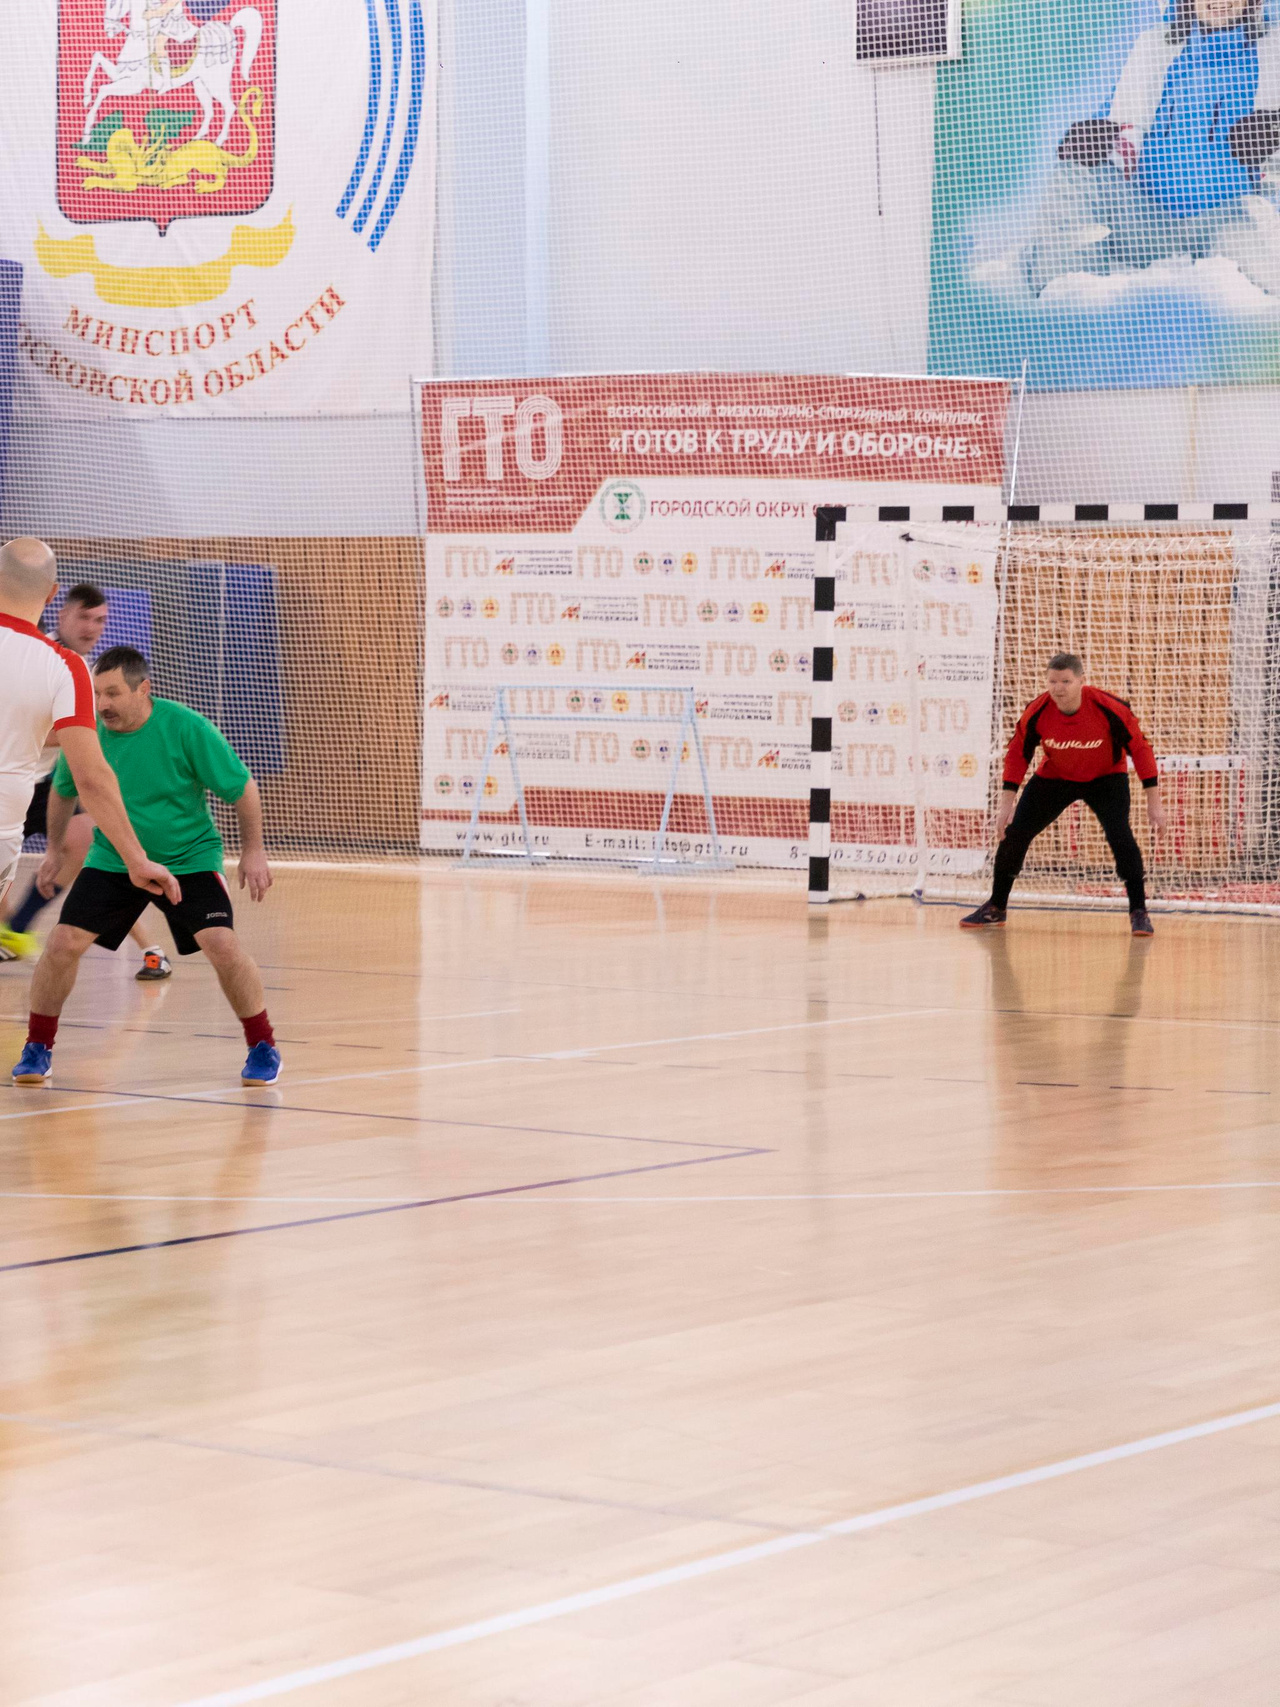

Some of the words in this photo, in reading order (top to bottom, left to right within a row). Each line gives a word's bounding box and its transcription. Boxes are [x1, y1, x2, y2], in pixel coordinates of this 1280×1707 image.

[62, 298, 259, 357] МИНСПОРТ
[19, 322, 194, 406] СКОВСКОЙ
[204, 284, 346, 398] ОБЛАСТИ
[442, 395, 563, 481] ГТО
[609, 429, 699, 454] «ГОТОВ
[706, 430, 721, 453] К
[729, 430, 811, 458] ТРУДУ
[816, 431, 836, 455] И
[842, 430, 982, 459] ОБОРОНЕ»
[650, 497, 751, 518] ГОРОДСКОЙ
[756, 500, 808, 519] ОКРУГ
[444, 545, 489, 577] ГТО
[577, 545, 623, 578] ГТО
[709, 547, 760, 580] ГТО
[510, 592, 555, 625] ГТО
[643, 593, 688, 627] ГТО
[780, 596, 814, 630] ГТ
[445, 636, 489, 668] ГТО
[577, 639, 620, 671] ГТО
[705, 640, 757, 676] ГТО
[510, 689, 555, 714] ГТО
[641, 691, 684, 716] ГТО
[777, 691, 813, 726] ГТ
[445, 728, 488, 760] ГТО
[574, 730, 619, 764] ГТО
[702, 735, 753, 770] ГТО
